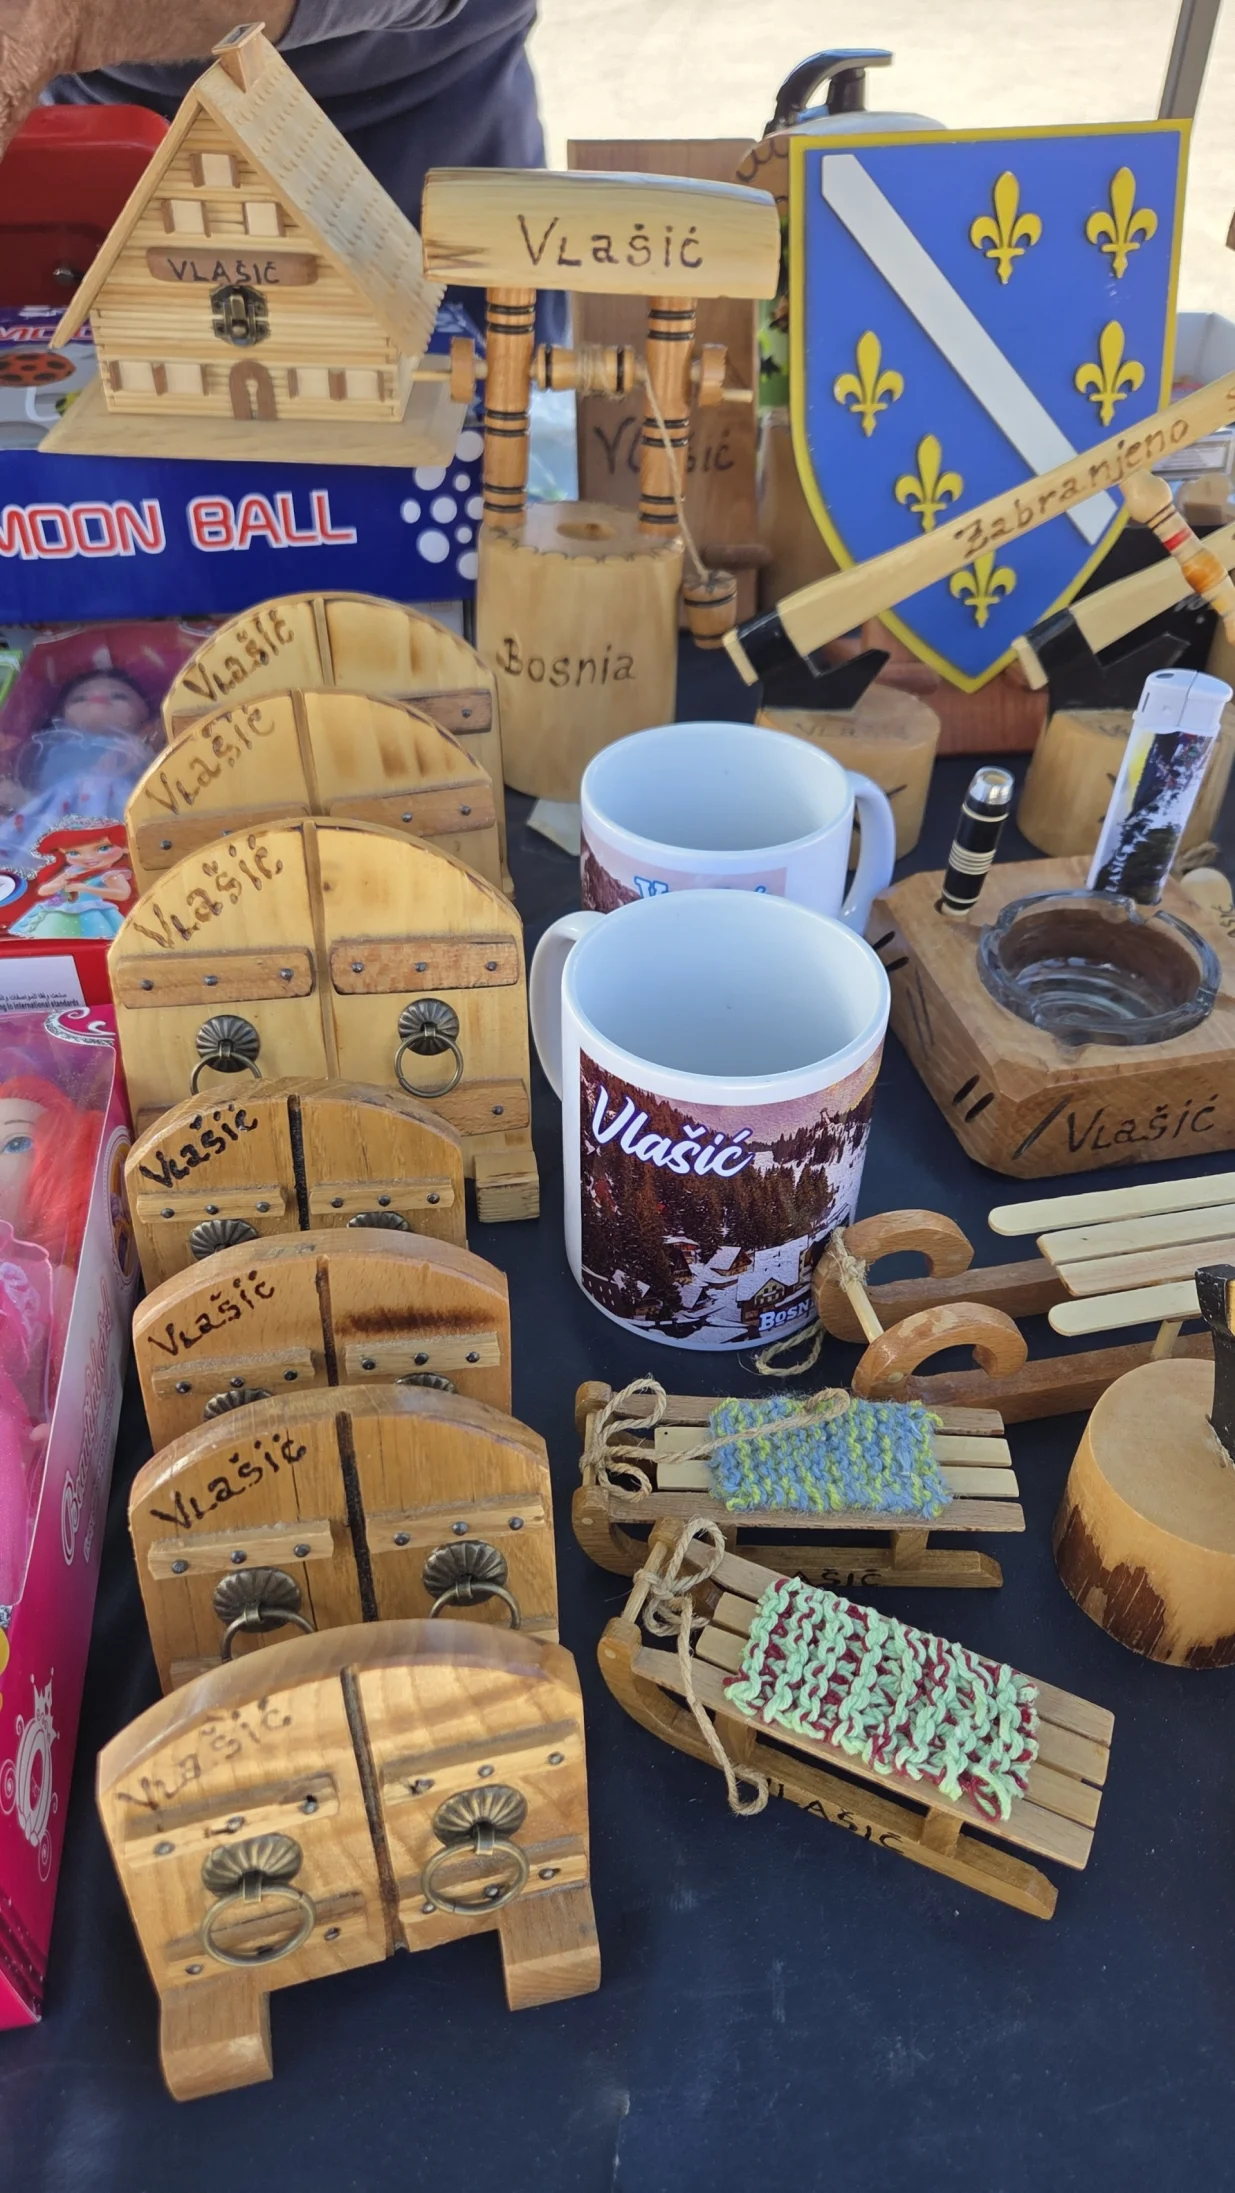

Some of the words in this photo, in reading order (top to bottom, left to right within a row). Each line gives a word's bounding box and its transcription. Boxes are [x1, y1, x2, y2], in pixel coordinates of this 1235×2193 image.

[953, 418, 1189, 559] Zabranjeno
[0, 498, 167, 561] MOON
[187, 489, 358, 551] BALL
[498, 637, 636, 688] Bosnia
[50, 998, 79, 1008] standards
[590, 1084, 756, 1178] Vlašić
